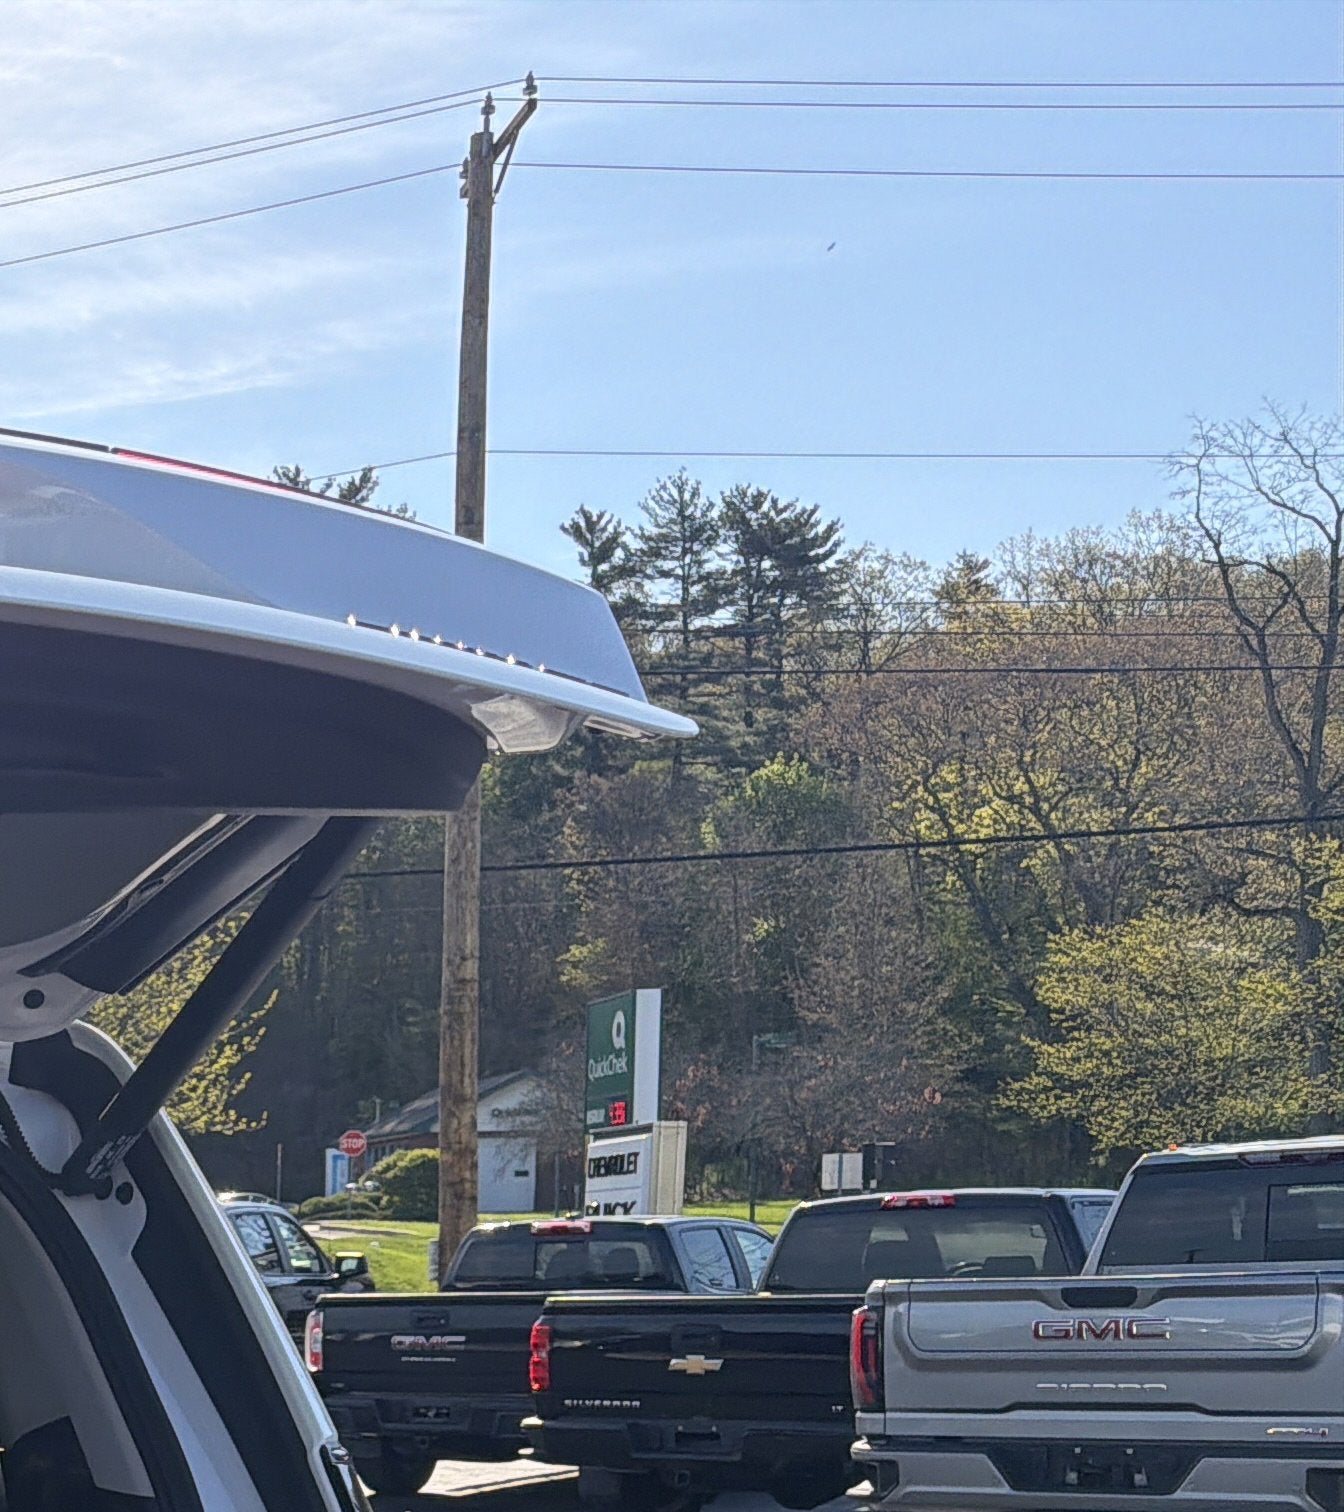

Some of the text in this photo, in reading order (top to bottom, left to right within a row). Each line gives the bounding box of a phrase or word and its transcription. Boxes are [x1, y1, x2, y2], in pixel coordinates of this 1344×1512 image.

[588, 1051, 628, 1081] QuickChek
[342, 1138, 364, 1149] STOP
[1039, 1318, 1170, 1340] GMC
[391, 1335, 465, 1350] GMC
